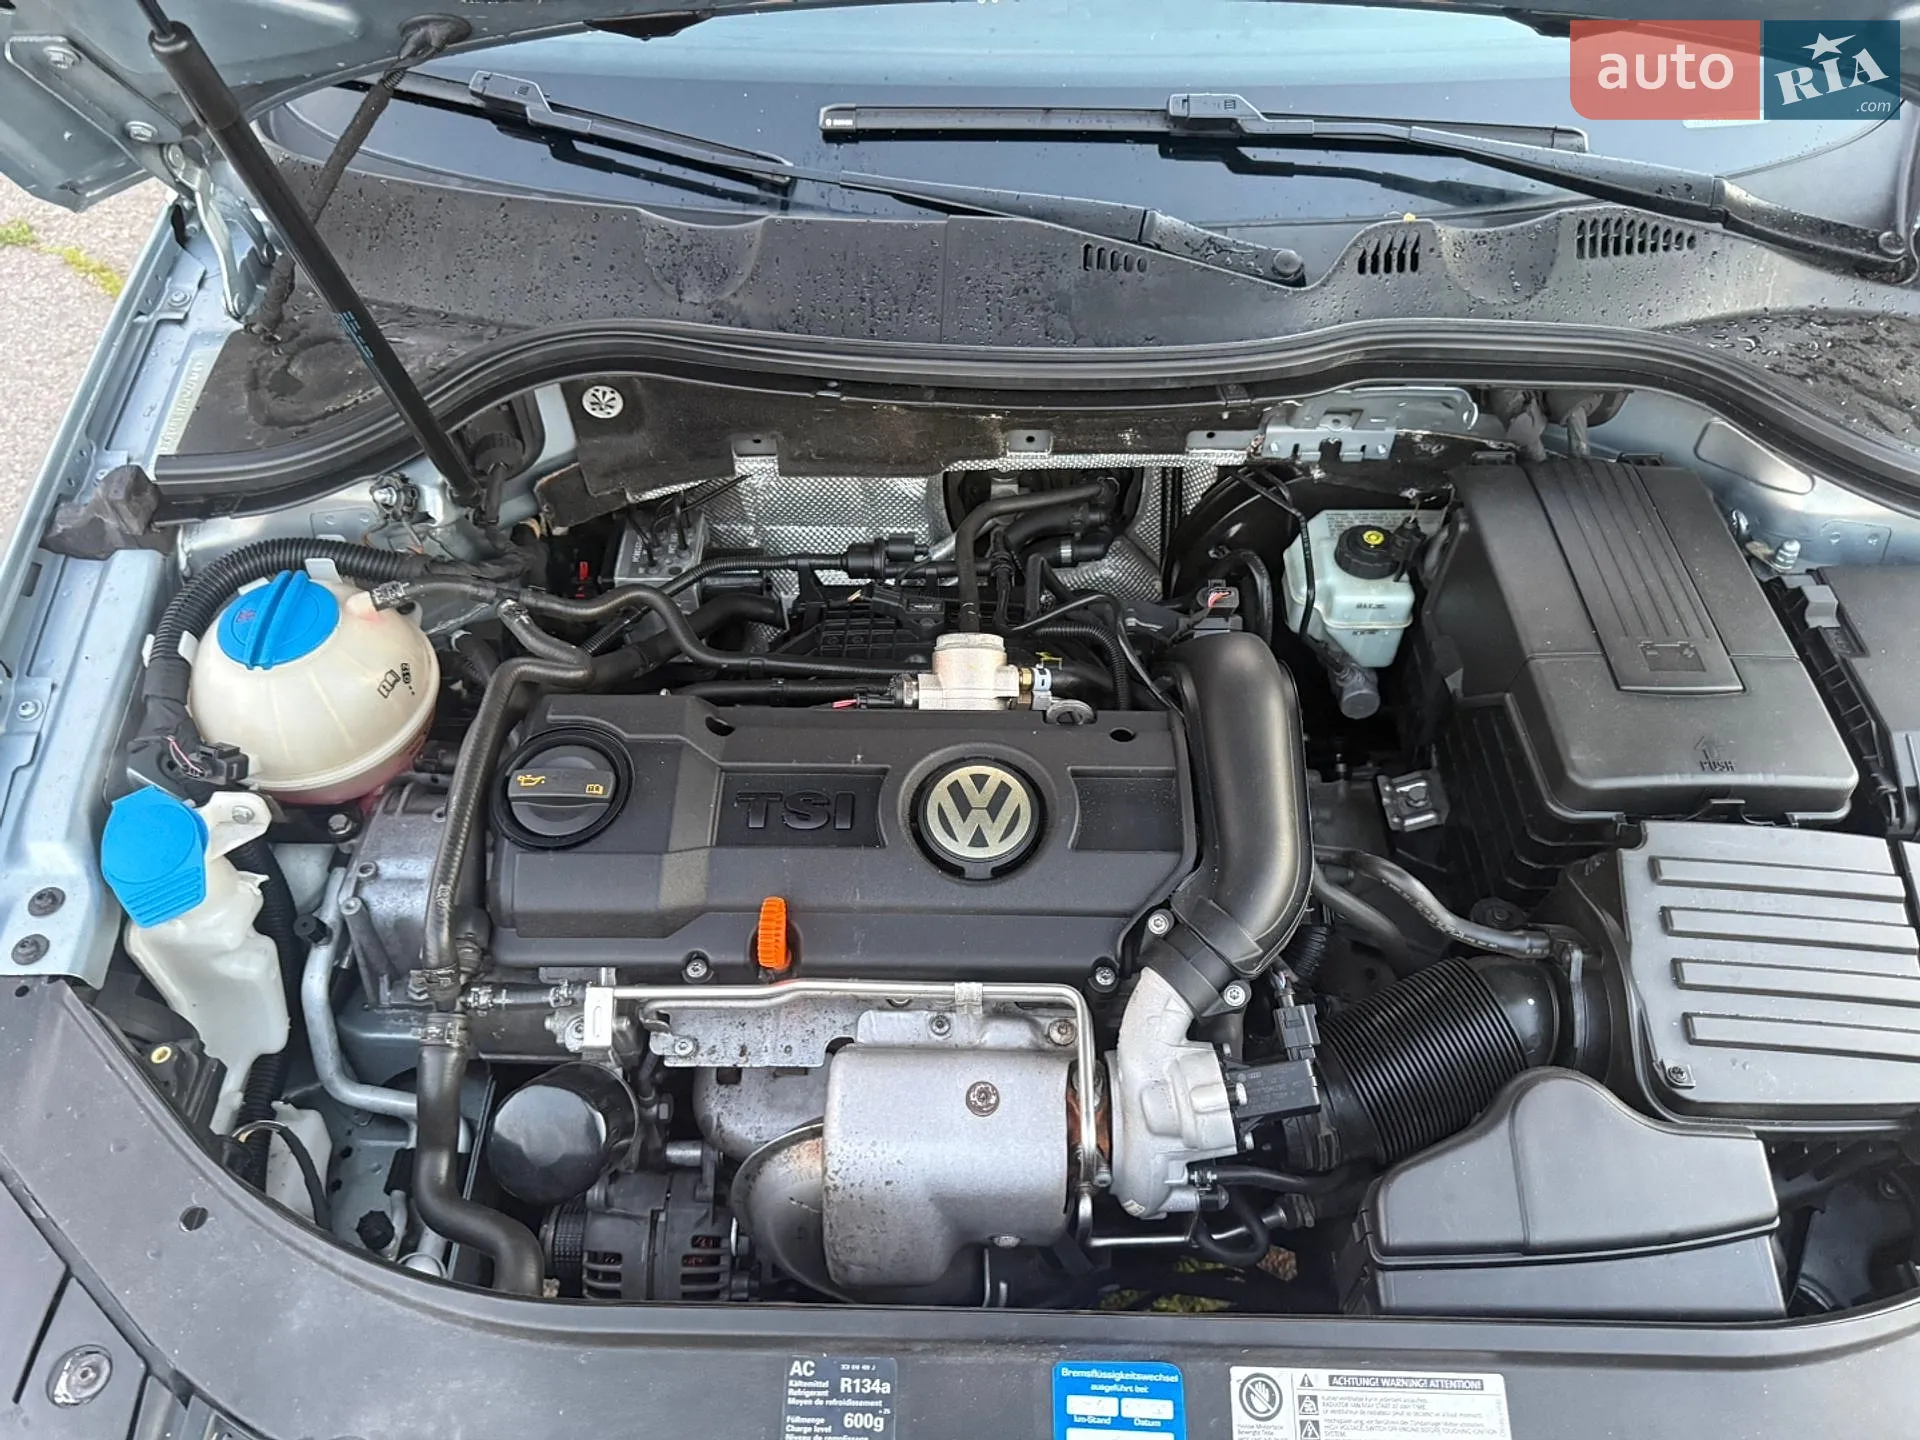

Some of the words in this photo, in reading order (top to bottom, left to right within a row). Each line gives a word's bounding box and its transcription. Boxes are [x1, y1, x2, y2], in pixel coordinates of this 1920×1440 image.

[1700, 760, 1735, 772] PUSH
[736, 791, 856, 830] TSI
[789, 1360, 815, 1376] AC
[840, 1377, 891, 1394] R134a
[1331, 1376, 1379, 1387] ACHTUNG!
[1380, 1377, 1428, 1388] WARNING!
[1429, 1379, 1482, 1390] ATTENTION!
[787, 1397, 813, 1406] Moyen
[814, 1398, 824, 1406] de
[843, 1412, 884, 1432] 600g
[1133, 1416, 1161, 1427] Datum
[785, 1424, 812, 1434] Charge
